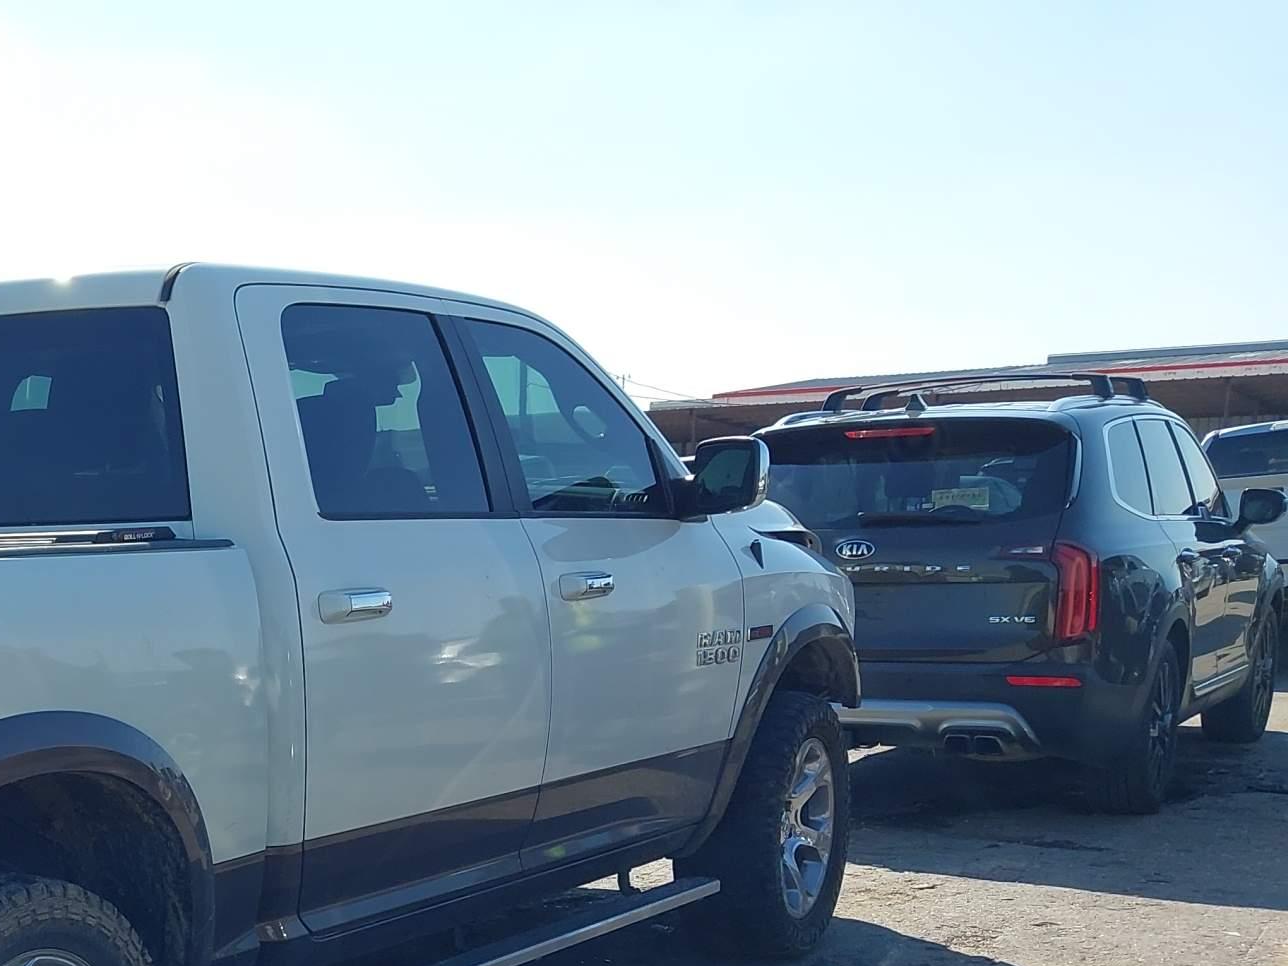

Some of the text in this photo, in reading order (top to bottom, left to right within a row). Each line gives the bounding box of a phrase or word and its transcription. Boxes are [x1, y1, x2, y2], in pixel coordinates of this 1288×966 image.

[842, 544, 868, 556] KIA
[696, 630, 741, 648] RAM
[696, 645, 740, 667] 1500
